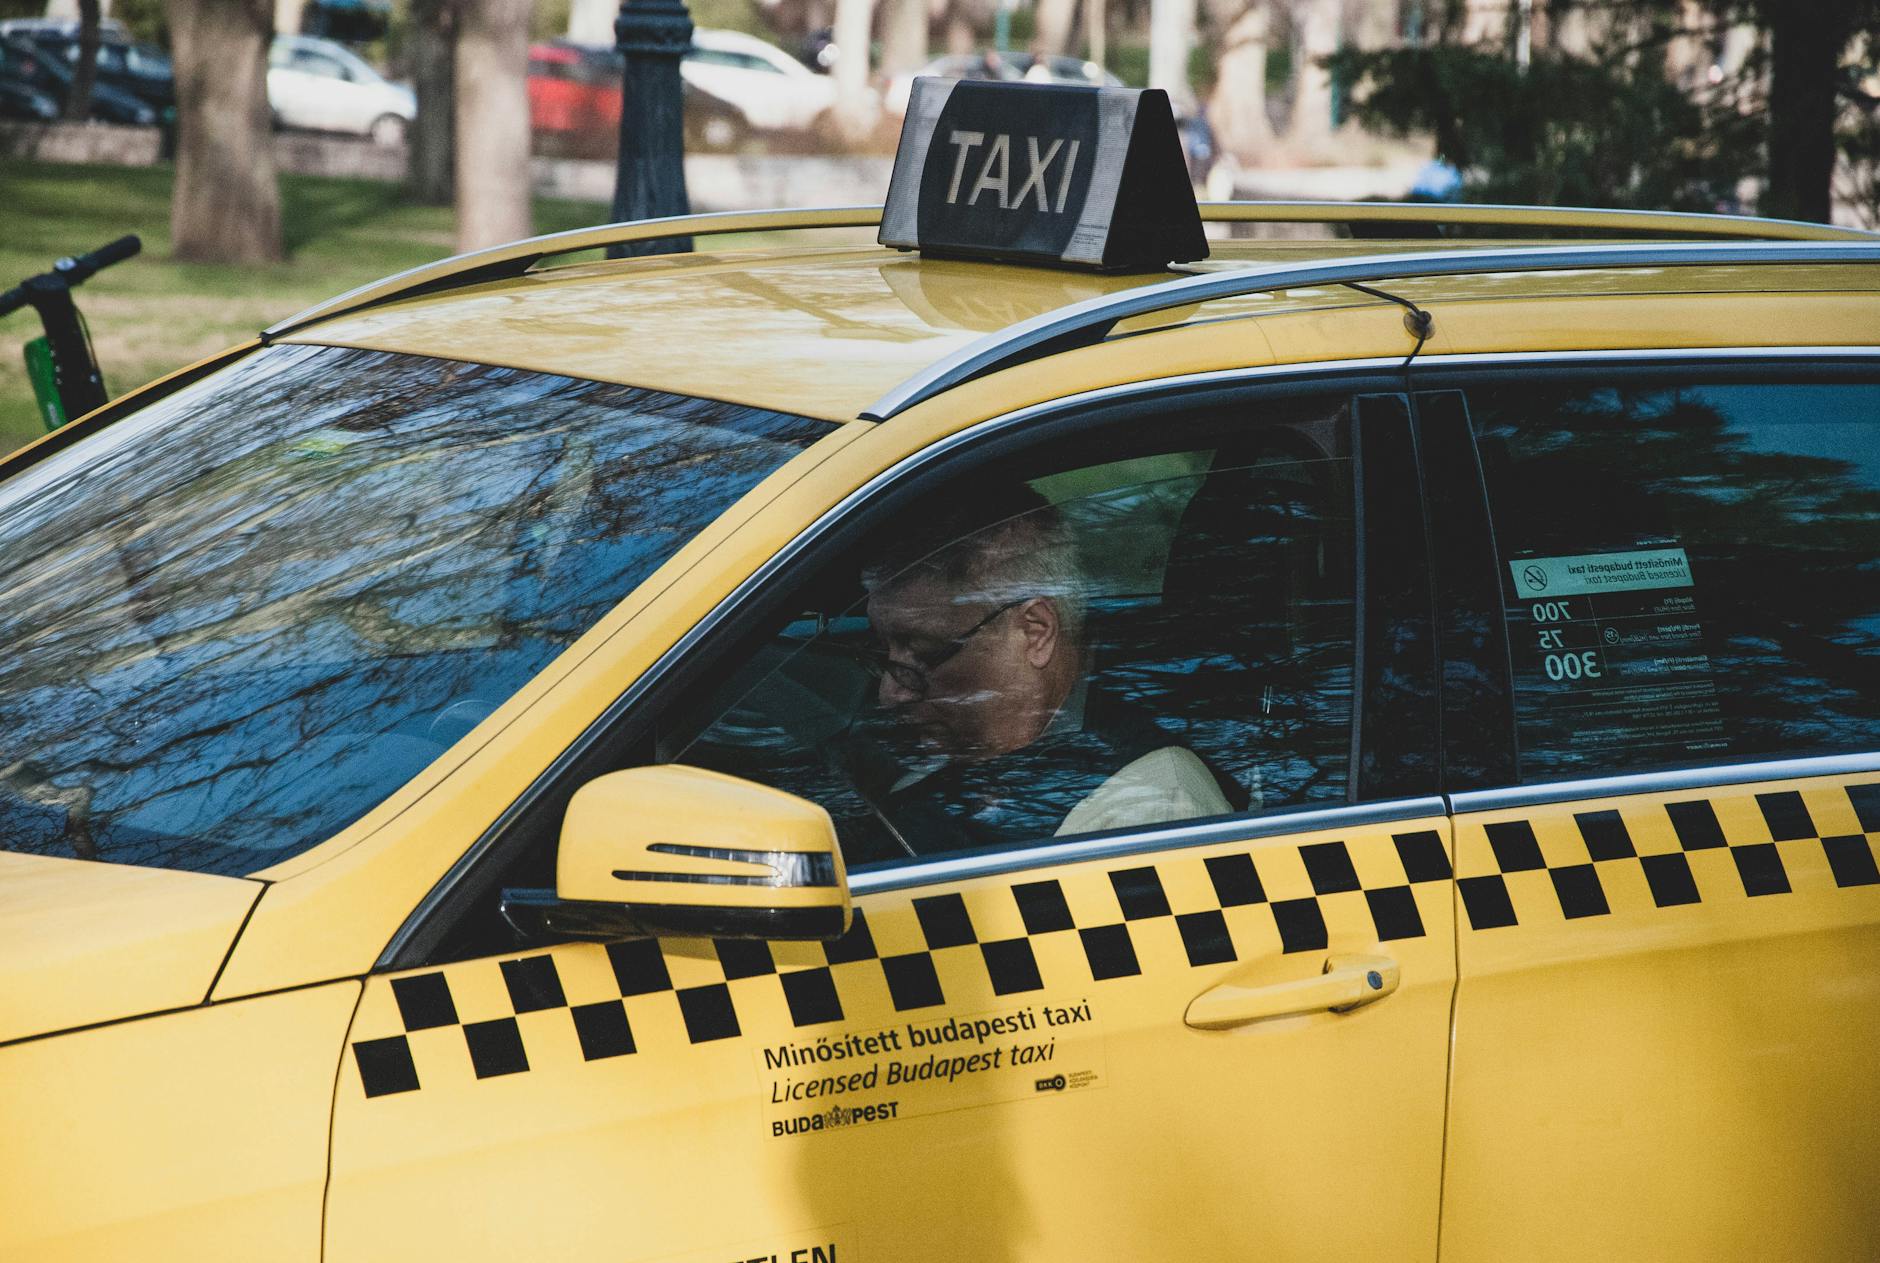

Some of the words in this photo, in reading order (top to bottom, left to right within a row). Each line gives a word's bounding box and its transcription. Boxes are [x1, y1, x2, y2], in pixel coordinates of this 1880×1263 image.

[946, 130, 1081, 214] TAXI
[763, 1029, 903, 1071] Minősített
[907, 1007, 1036, 1048] budapesti
[1042, 999, 1093, 1028] taxi
[771, 1060, 878, 1104] Licensed
[886, 1047, 1002, 1085] Budapest
[1010, 1037, 1056, 1067] taxi
